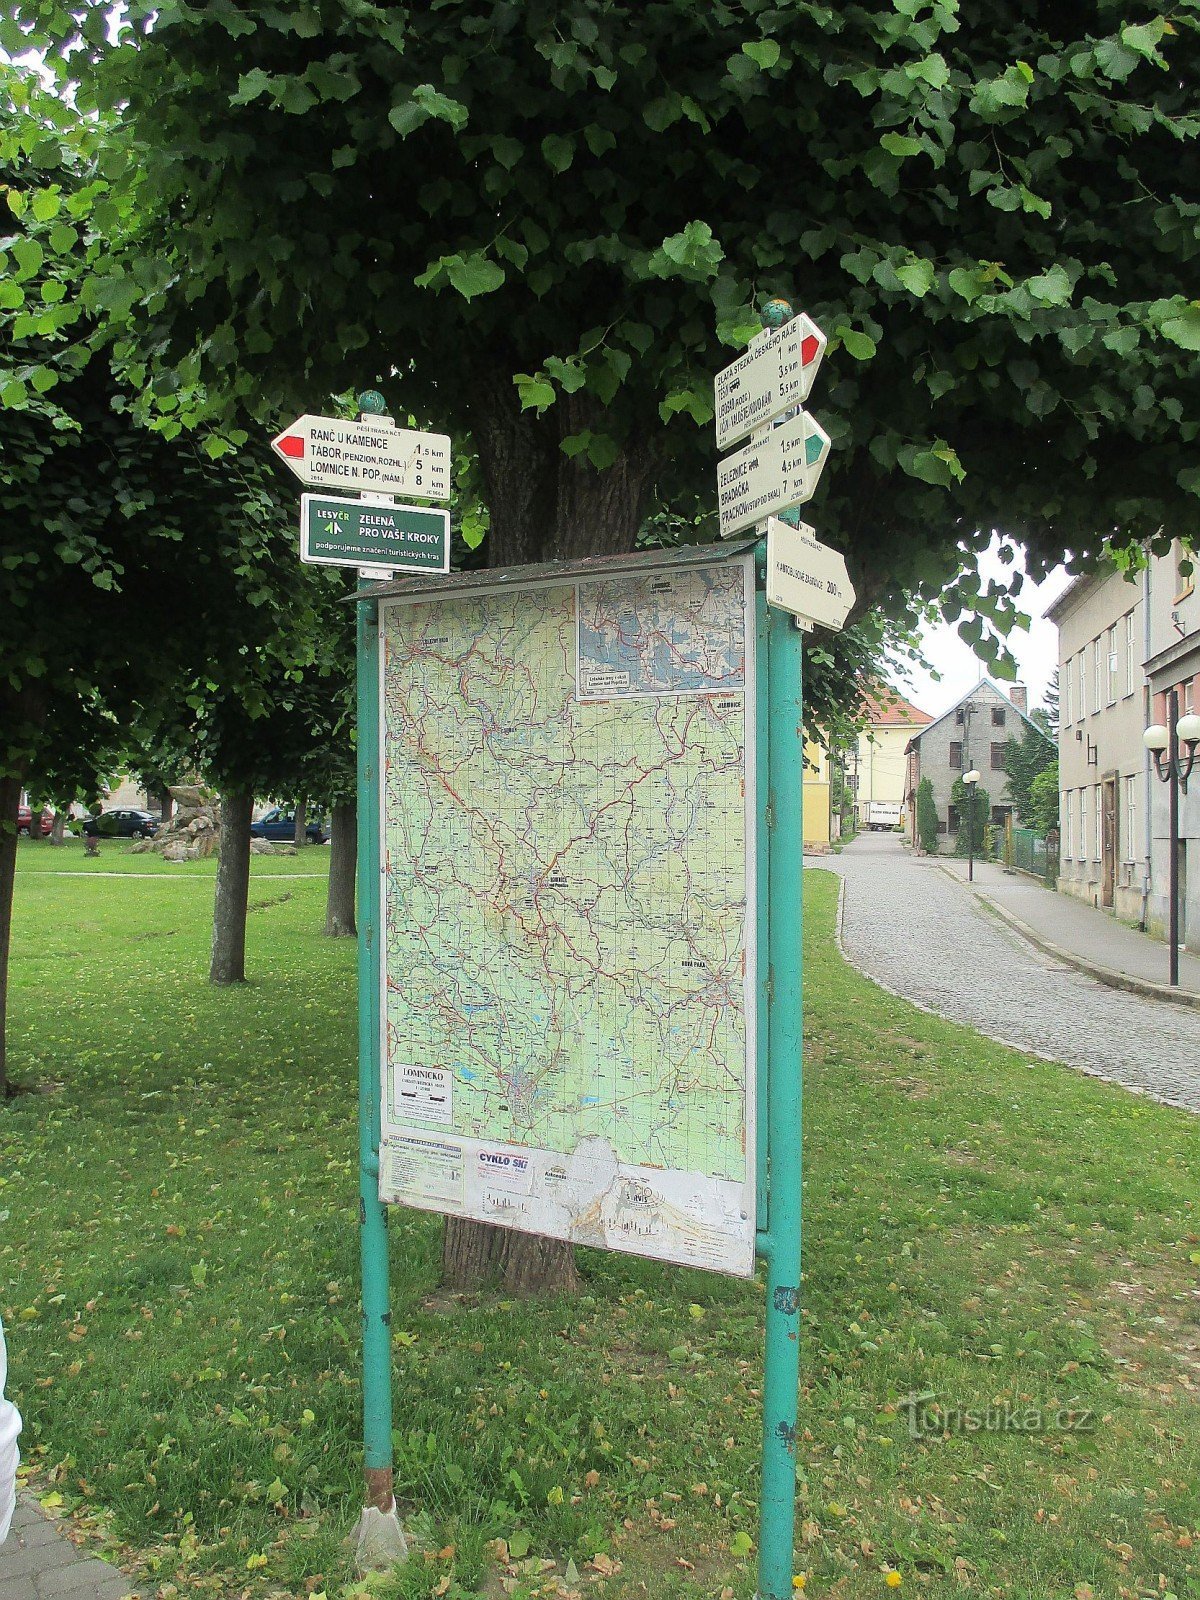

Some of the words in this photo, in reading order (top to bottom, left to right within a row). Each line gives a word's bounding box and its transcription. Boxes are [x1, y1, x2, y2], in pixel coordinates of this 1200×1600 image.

[718, 367, 733, 386] ZLATÁ
[734, 354, 753, 375] STEZKA
[754, 335, 780, 359] ČESKÉHO
[781, 322, 797, 340] RÁJE
[777, 347, 782, 360] 1
[788, 342, 798, 354] km
[778, 365, 788, 379] 3,5
[789, 361, 798, 372] km
[780, 383, 788, 396] 5,5
[789, 380, 799, 390] km
[370, 427, 389, 435] TRASA
[310, 429, 335, 442] RANČ
[337, 432, 344, 444] U
[346, 433, 388, 449] KAMENCE
[413, 443, 430, 456] 1,5
[431, 449, 444, 458] km
[310, 443, 342, 459] TÁBOR
[416, 459, 423, 470] 5
[431, 465, 444, 473] km
[720, 461, 747, 488] ŽELEZNICE
[780, 440, 790, 453] 1,5
[791, 437, 801, 448] km
[310, 461, 350, 476] LOMNICE
[351, 466, 360, 477] N.
[362, 467, 381, 480] POP.
[381, 473, 405, 486] (NÁM.)
[415, 475, 422, 486] 8
[431, 480, 444, 488] km
[720, 480, 750, 506] BRADAČKA
[781, 459, 791, 473] 4,5
[792, 458, 802, 468] km
[782, 480, 788, 493] 7
[793, 478, 803, 488] km
[359, 514, 395, 527] ZELENÁ
[359, 527, 379, 537] PRO
[380, 528, 405, 540] VAŠE
[407, 532, 440, 544] KROKY
[315, 542, 361, 552] podporujeme
[362, 547, 388, 555] značení
[388, 549, 426, 559] turistických
[427, 552, 440, 560] tras
[826, 580, 837, 595] 200
[403, 1068, 444, 1080] LOMNICKO
[479, 1153, 510, 1165] CYKLO
[626, 1193, 648, 1203] SRVIS
